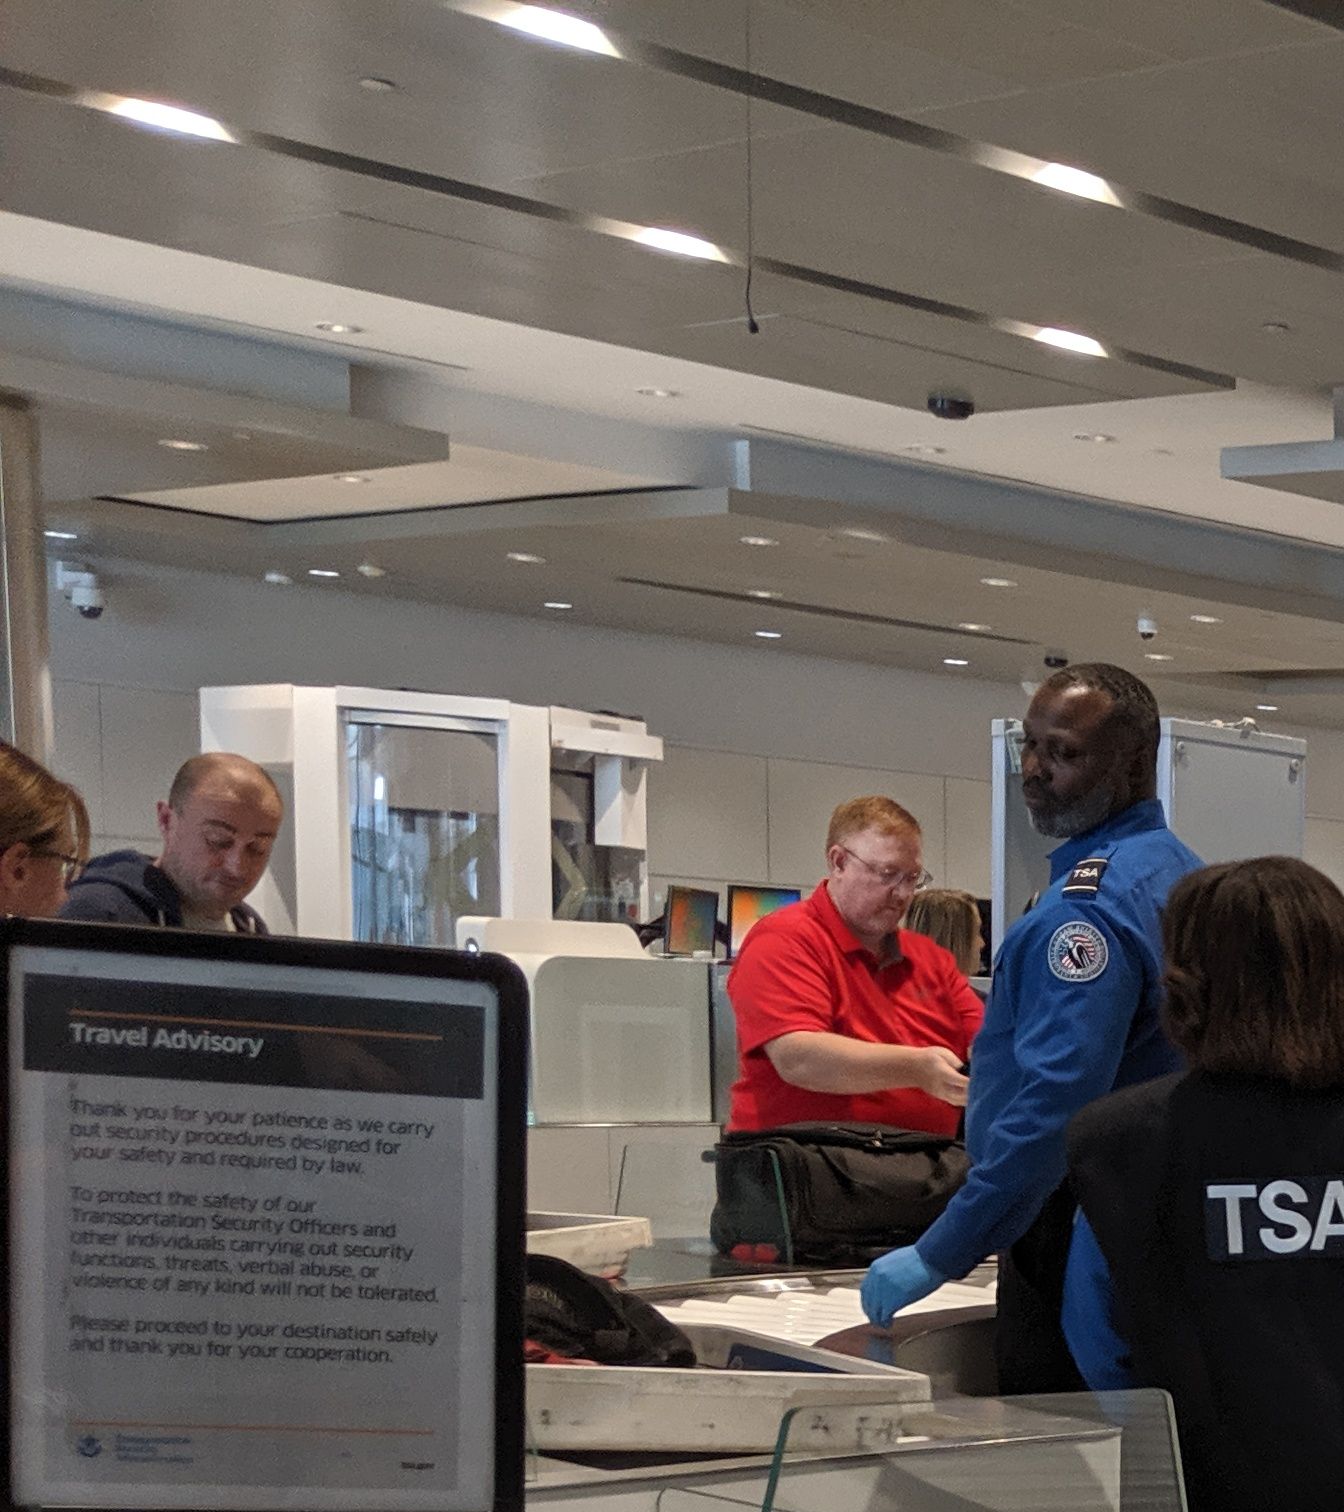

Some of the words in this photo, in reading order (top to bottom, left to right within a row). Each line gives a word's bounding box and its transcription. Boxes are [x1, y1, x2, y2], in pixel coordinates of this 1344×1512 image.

[1073, 867, 1099, 879] TSA
[69, 1023, 148, 1047] Travel
[153, 1028, 264, 1058] Advisory
[70, 1099, 127, 1117] Thank
[133, 1106, 168, 1121] you
[171, 1104, 199, 1121] for
[205, 1110, 247, 1125] your
[252, 1110, 328, 1130] patience
[333, 1117, 353, 1131] as
[358, 1119, 384, 1134] we
[388, 1121, 435, 1139] carry
[70, 1122, 100, 1137] out
[106, 1124, 180, 1144] security
[185, 1130, 286, 1149] procedures
[291, 1134, 370, 1154] designed
[376, 1138, 402, 1155] for
[71, 1146, 112, 1161] your
[120, 1146, 176, 1166] safety
[180, 1151, 215, 1166] and
[220, 1154, 298, 1170] required
[302, 1156, 325, 1174] by
[330, 1157, 365, 1175] law.
[71, 1186, 93, 1201] To
[168, 1190, 198, 1207] the
[203, 1193, 257, 1212] safety
[263, 1196, 282, 1212] of
[287, 1200, 317, 1213] our
[72, 1207, 206, 1228] Transportation
[212, 1214, 284, 1235] Security
[290, 1218, 358, 1236] Officers
[363, 1223, 396, 1238] and
[70, 1231, 117, 1246] other
[127, 1233, 225, 1251] individuals
[230, 1239, 304, 1258] carrying
[310, 1241, 338, 1256] out
[344, 1243, 414, 1262] security
[238, 1260, 294, 1276] verbal
[360, 1265, 379, 1279] or
[153, 1275, 173, 1291] of
[177, 1278, 209, 1295] any
[215, 1278, 255, 1295] kind
[260, 1281, 291, 1295] will
[298, 1283, 325, 1298] not
[331, 1283, 353, 1299] be
[135, 1319, 208, 1335] proceed
[213, 1320, 232, 1336] to
[237, 1323, 277, 1339] your
[282, 1323, 382, 1342] destination
[386, 1326, 438, 1346] safely
[70, 1337, 104, 1352] and
[109, 1337, 162, 1353] thank
[168, 1341, 201, 1357] you
[207, 1340, 232, 1357] for
[239, 1344, 279, 1359] your
[284, 1346, 393, 1363] cooperation.
